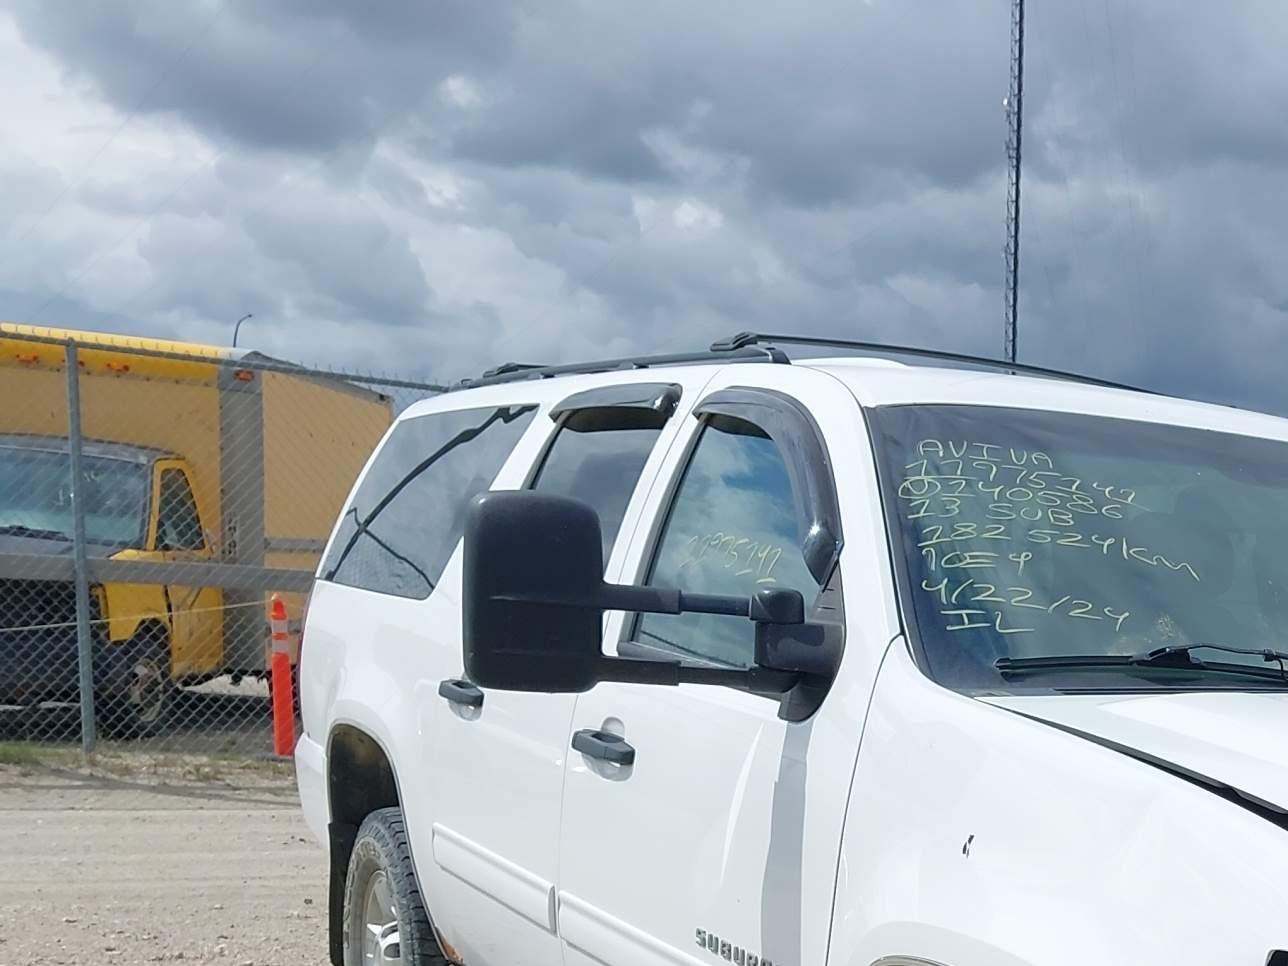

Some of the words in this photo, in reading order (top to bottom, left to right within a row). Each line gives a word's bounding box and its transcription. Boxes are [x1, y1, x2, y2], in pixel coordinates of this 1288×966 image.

[916, 439, 1054, 469] AVIVA
[907, 498, 960, 519] 13
[985, 502, 1075, 526] SUB
[917, 522, 1012, 547] 182
